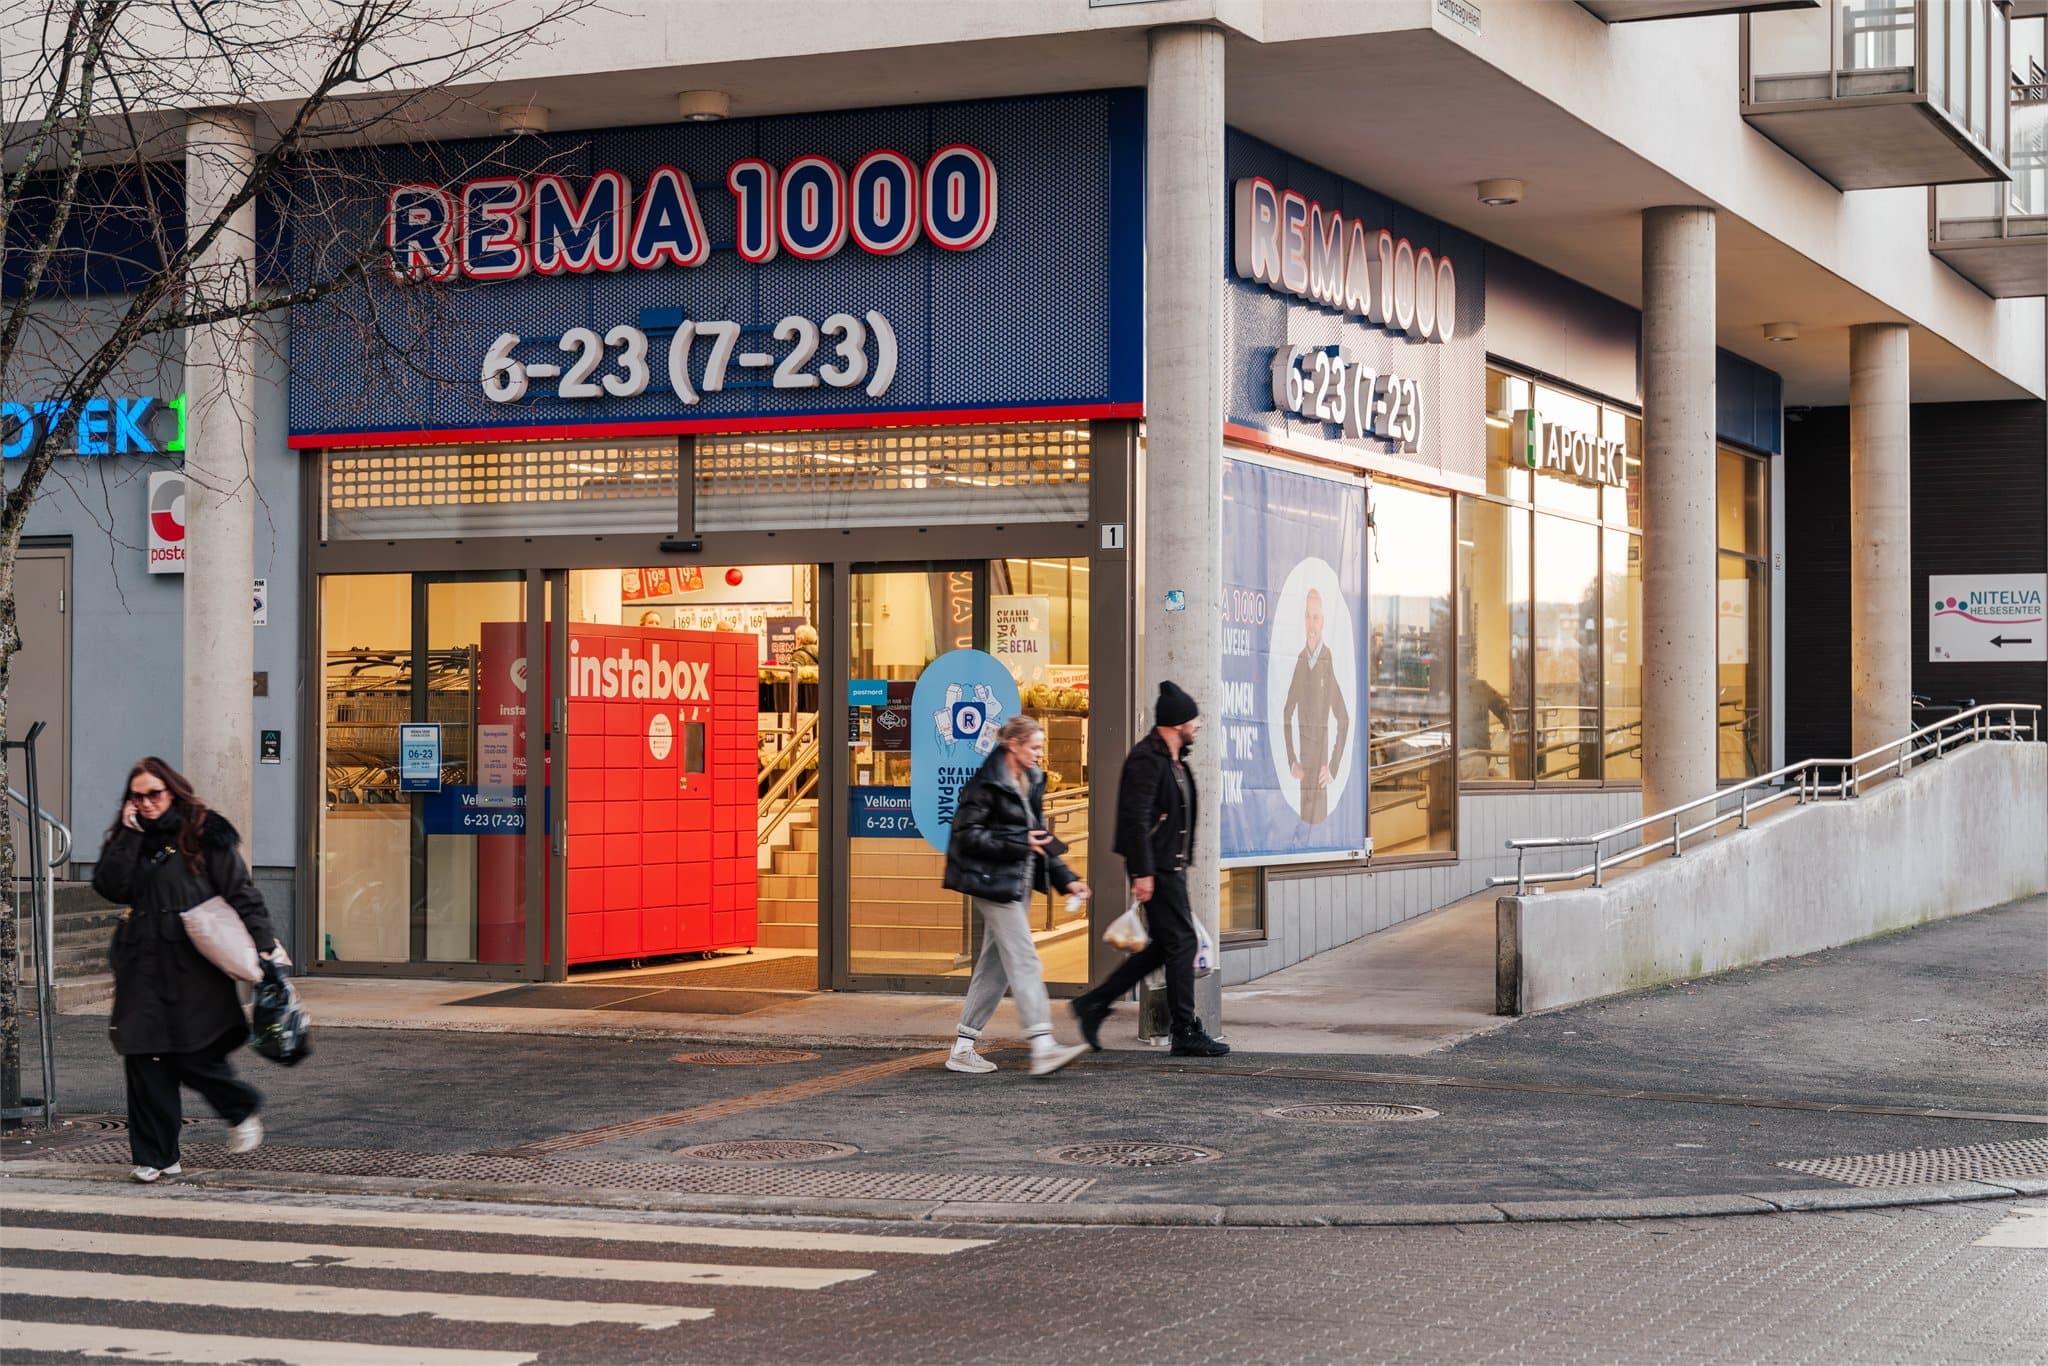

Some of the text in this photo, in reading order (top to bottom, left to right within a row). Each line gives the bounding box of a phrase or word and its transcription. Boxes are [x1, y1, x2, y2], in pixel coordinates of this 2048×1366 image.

[385, 143, 998, 282] REMA 1000
[1246, 176, 1456, 344] REMA 1000
[481, 309, 898, 404] 6-23 (7-23)
[1285, 344, 1423, 454] 6-23 (7-23)
[1547, 422, 1619, 487] APOTEK
[1110, 527, 1116, 546] 1
[1970, 591, 2041, 605] NITELVA
[996, 609, 1029, 623] SKANN
[1970, 606, 2041, 616] HELSESENTER
[1010, 639, 1038, 653] BETAL
[570, 638, 711, 701] instabox
[963, 711, 976, 730] R
[408, 750, 433, 759] 06-23
[464, 814, 525, 828] 6-23 (7-23)
[867, 816, 895, 829] 6-23
